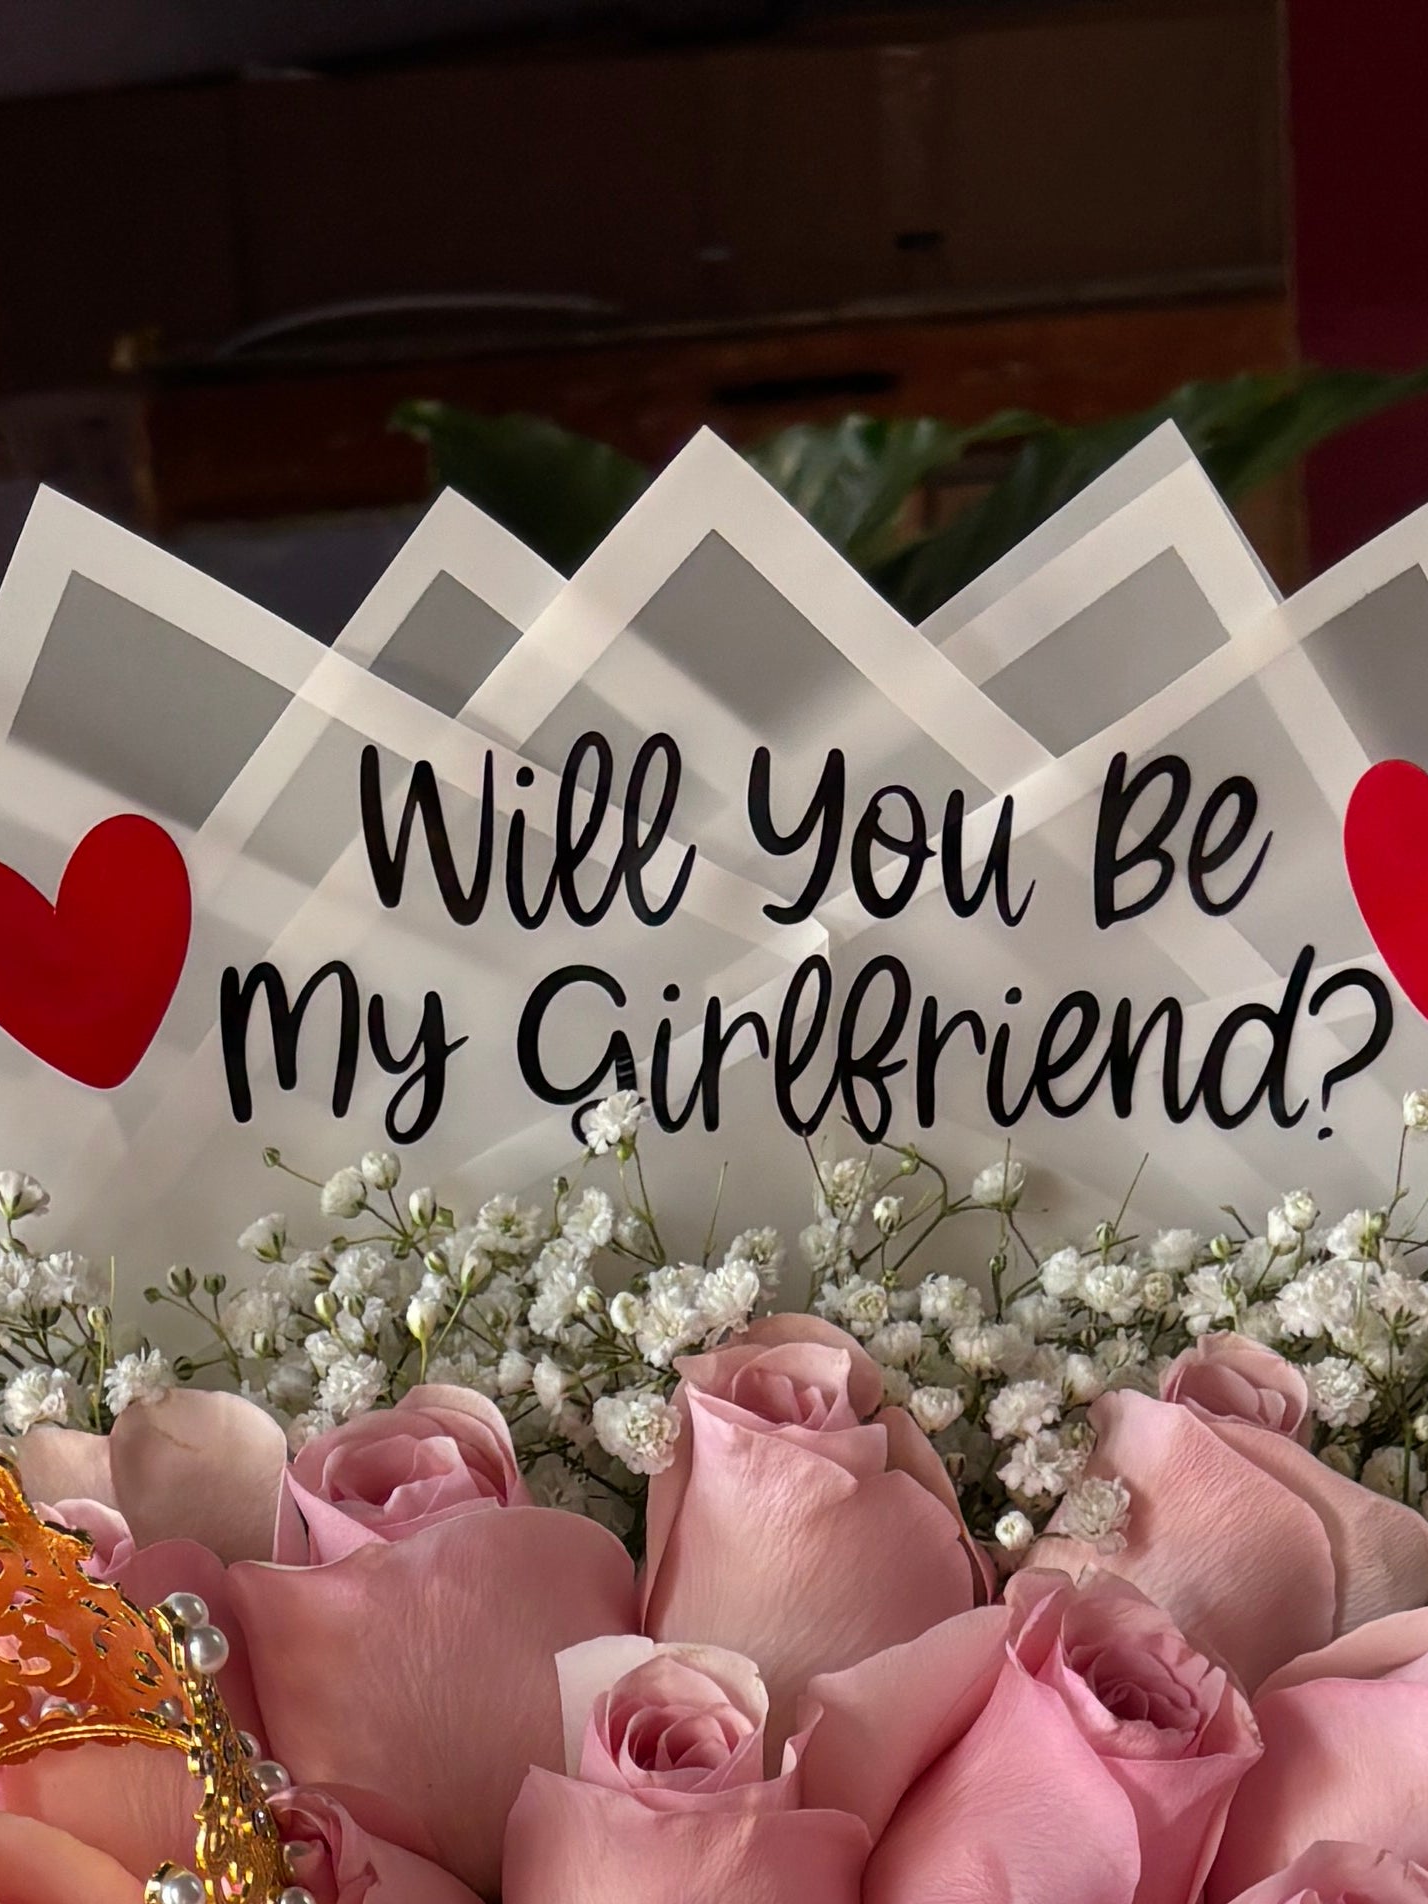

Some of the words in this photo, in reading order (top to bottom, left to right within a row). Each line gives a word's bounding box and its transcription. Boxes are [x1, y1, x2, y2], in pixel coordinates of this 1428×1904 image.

[360, 730, 697, 930] Will
[747, 746, 1036, 927] You
[1093, 751, 1274, 930] Be
[220, 960, 469, 1145] My
[516, 944, 1394, 1146] Girlfriend?
